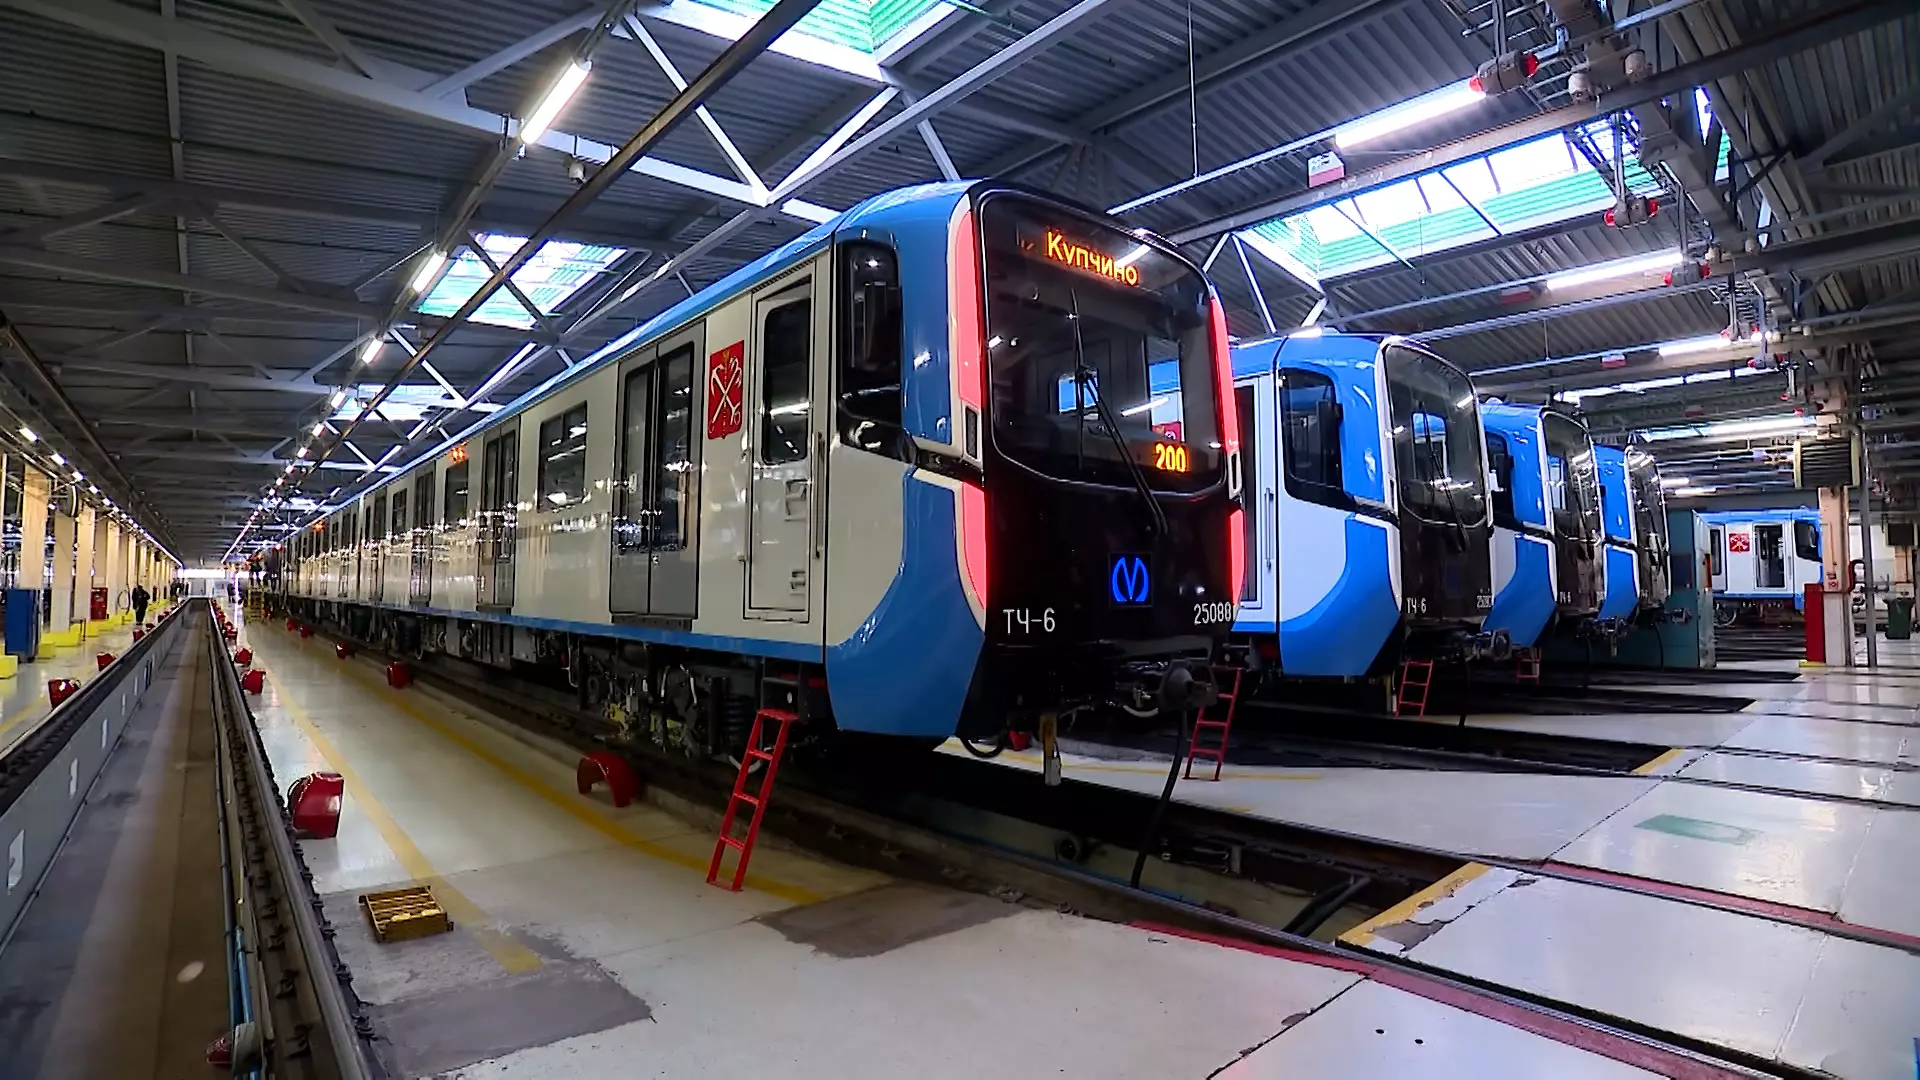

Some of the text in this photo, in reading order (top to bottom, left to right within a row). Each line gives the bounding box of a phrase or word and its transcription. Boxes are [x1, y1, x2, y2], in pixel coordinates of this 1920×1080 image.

[1046, 230, 1139, 287] Купчино
[1155, 442, 1187, 473] 200
[1002, 607, 1056, 635] ТЧ-6
